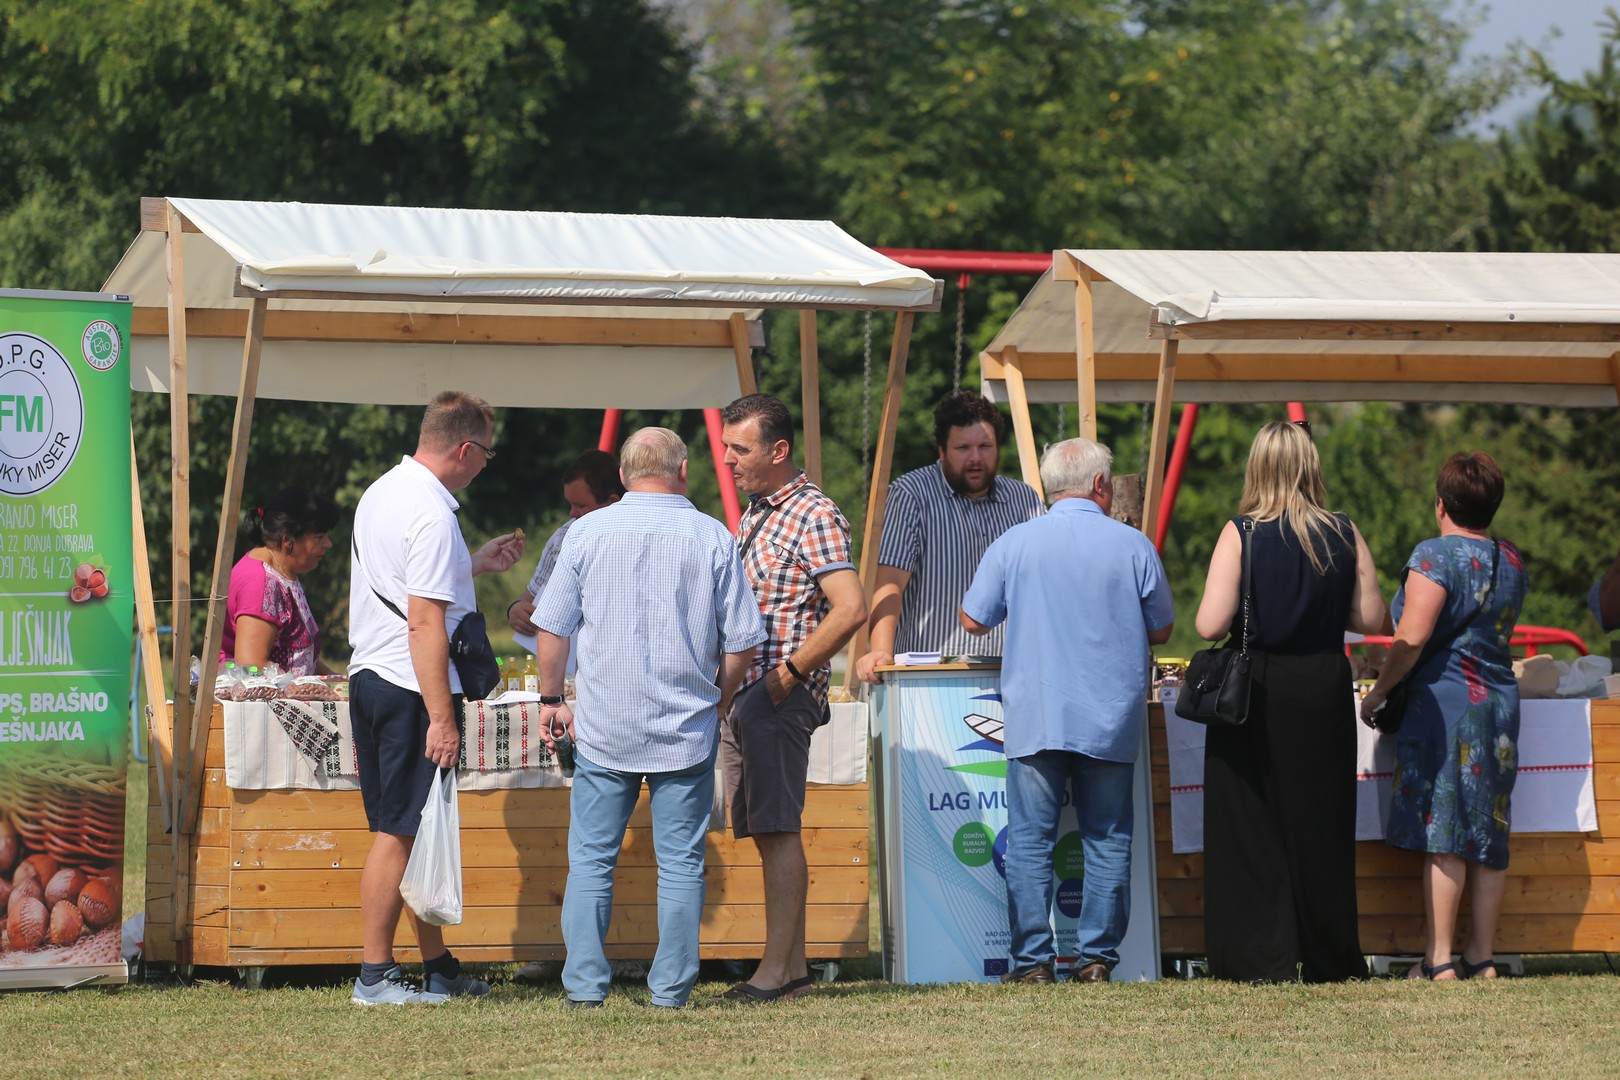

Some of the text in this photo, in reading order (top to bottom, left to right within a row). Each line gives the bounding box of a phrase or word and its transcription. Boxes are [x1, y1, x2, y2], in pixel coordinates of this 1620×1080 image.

[86, 324, 112, 341] AUSTRIA
[92, 337, 110, 354] Bio
[89, 349, 117, 368] GARANTIE
[0, 395, 43, 432] FM
[27, 431, 70, 481] MISER
[41, 504, 78, 529] MISER
[24, 534, 52, 552] DONJA
[55, 534, 94, 552] DUBRAVA
[19, 556, 38, 579] 796
[44, 556, 54, 579] 41
[59, 556, 72, 579] 23
[0, 604, 73, 666] LJEŠNJAK
[30, 687, 108, 712] BRAŠNO
[0, 716, 85, 742] EŠNJAKA
[929, 792, 970, 811] LAG
